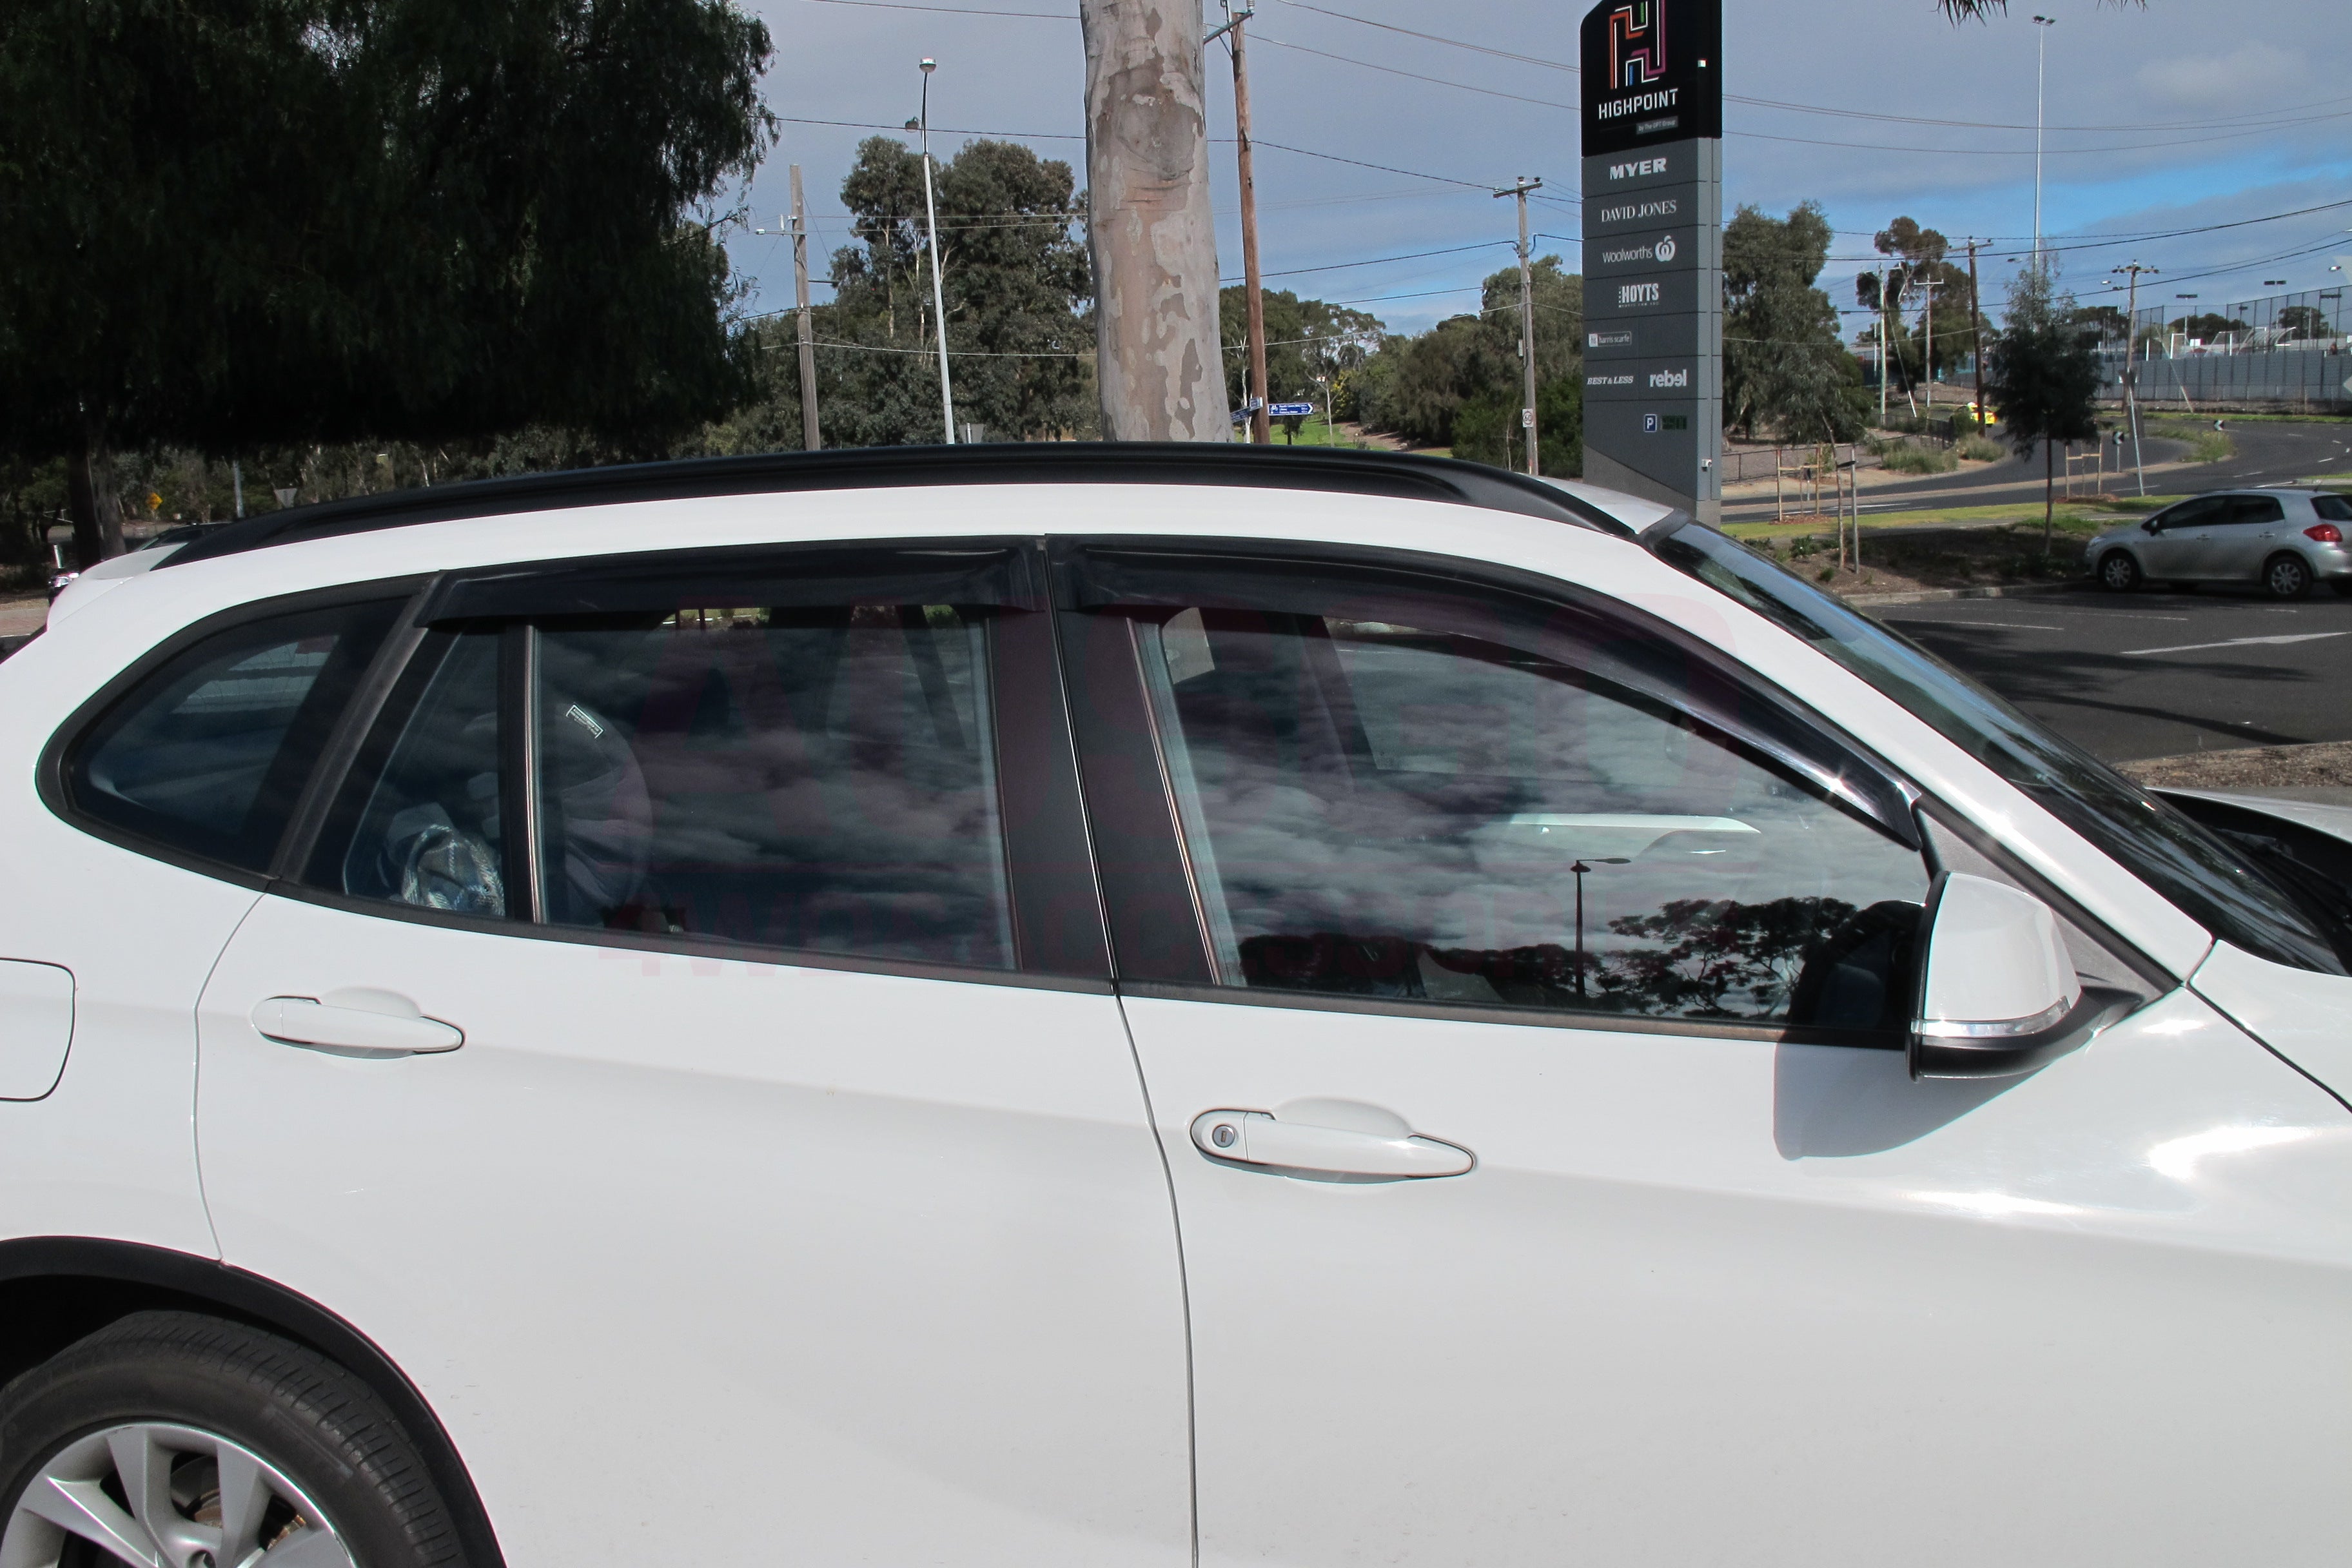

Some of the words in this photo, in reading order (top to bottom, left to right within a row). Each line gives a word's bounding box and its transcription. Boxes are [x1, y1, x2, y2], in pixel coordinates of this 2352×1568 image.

[1598, 88, 1678, 120] HIGHPOINT
[1610, 157, 1667, 180] MYER
[1601, 206, 1636, 222] DAVID
[1638, 200, 1677, 218] JONES
[1602, 246, 1653, 263] Woolworths
[1622, 283, 1659, 303] HOYTS
[1613, 375, 1634, 384] LESS
[1649, 369, 1687, 387] rebel
[1647, 417, 1654, 429] P
